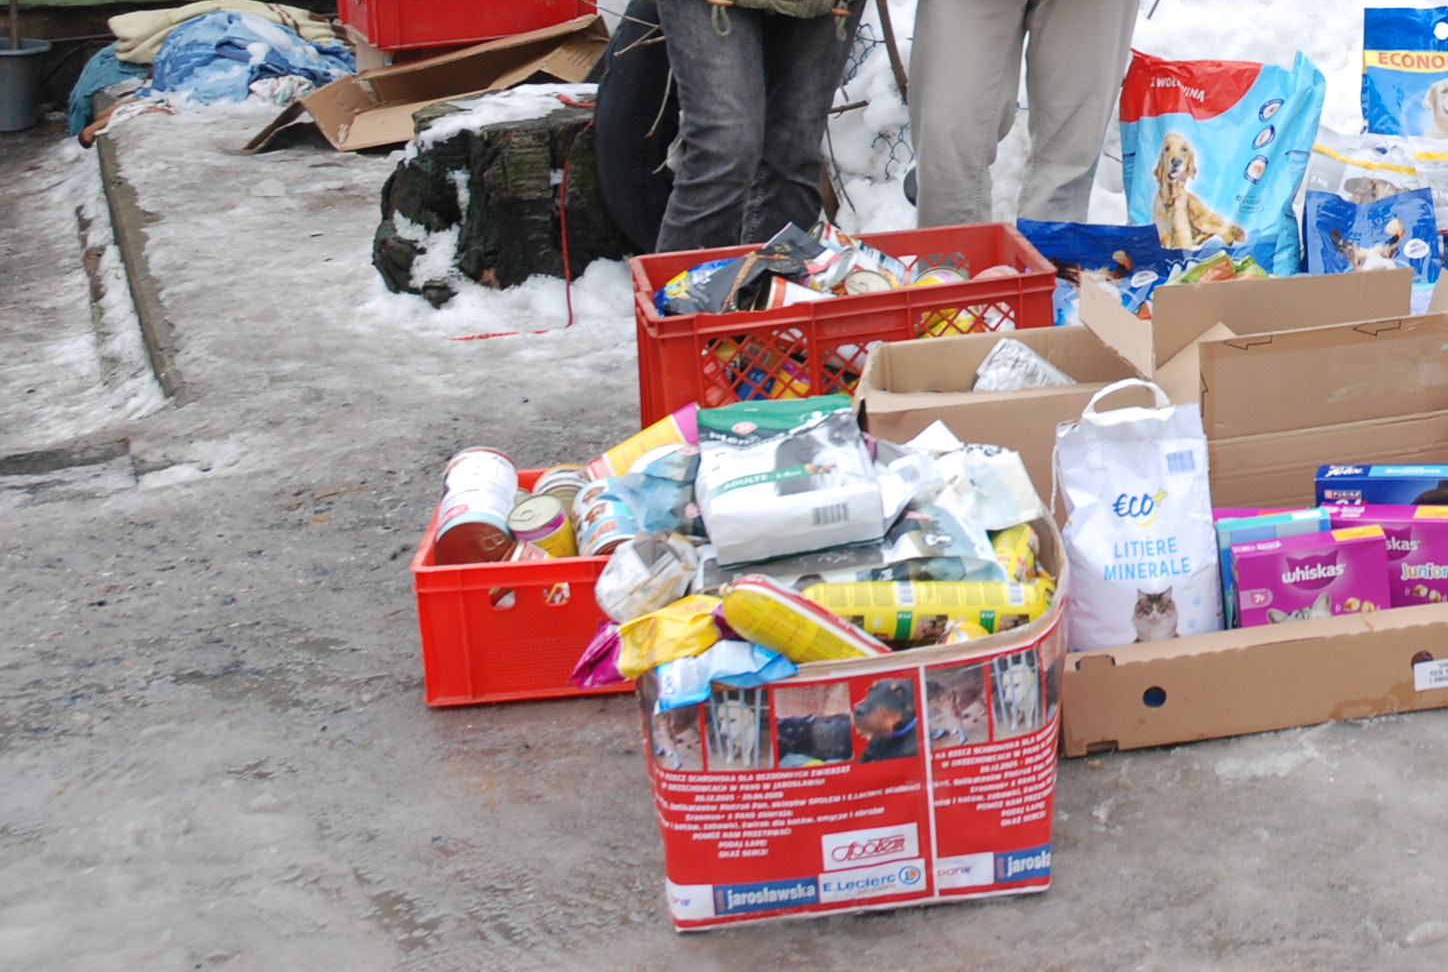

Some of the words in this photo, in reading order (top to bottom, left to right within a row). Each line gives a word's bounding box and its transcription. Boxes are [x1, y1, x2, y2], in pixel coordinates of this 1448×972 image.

[1386, 536, 1419, 553] skas
[1281, 563, 1345, 585] whiskas
[727, 883, 816, 910] jarosławska
